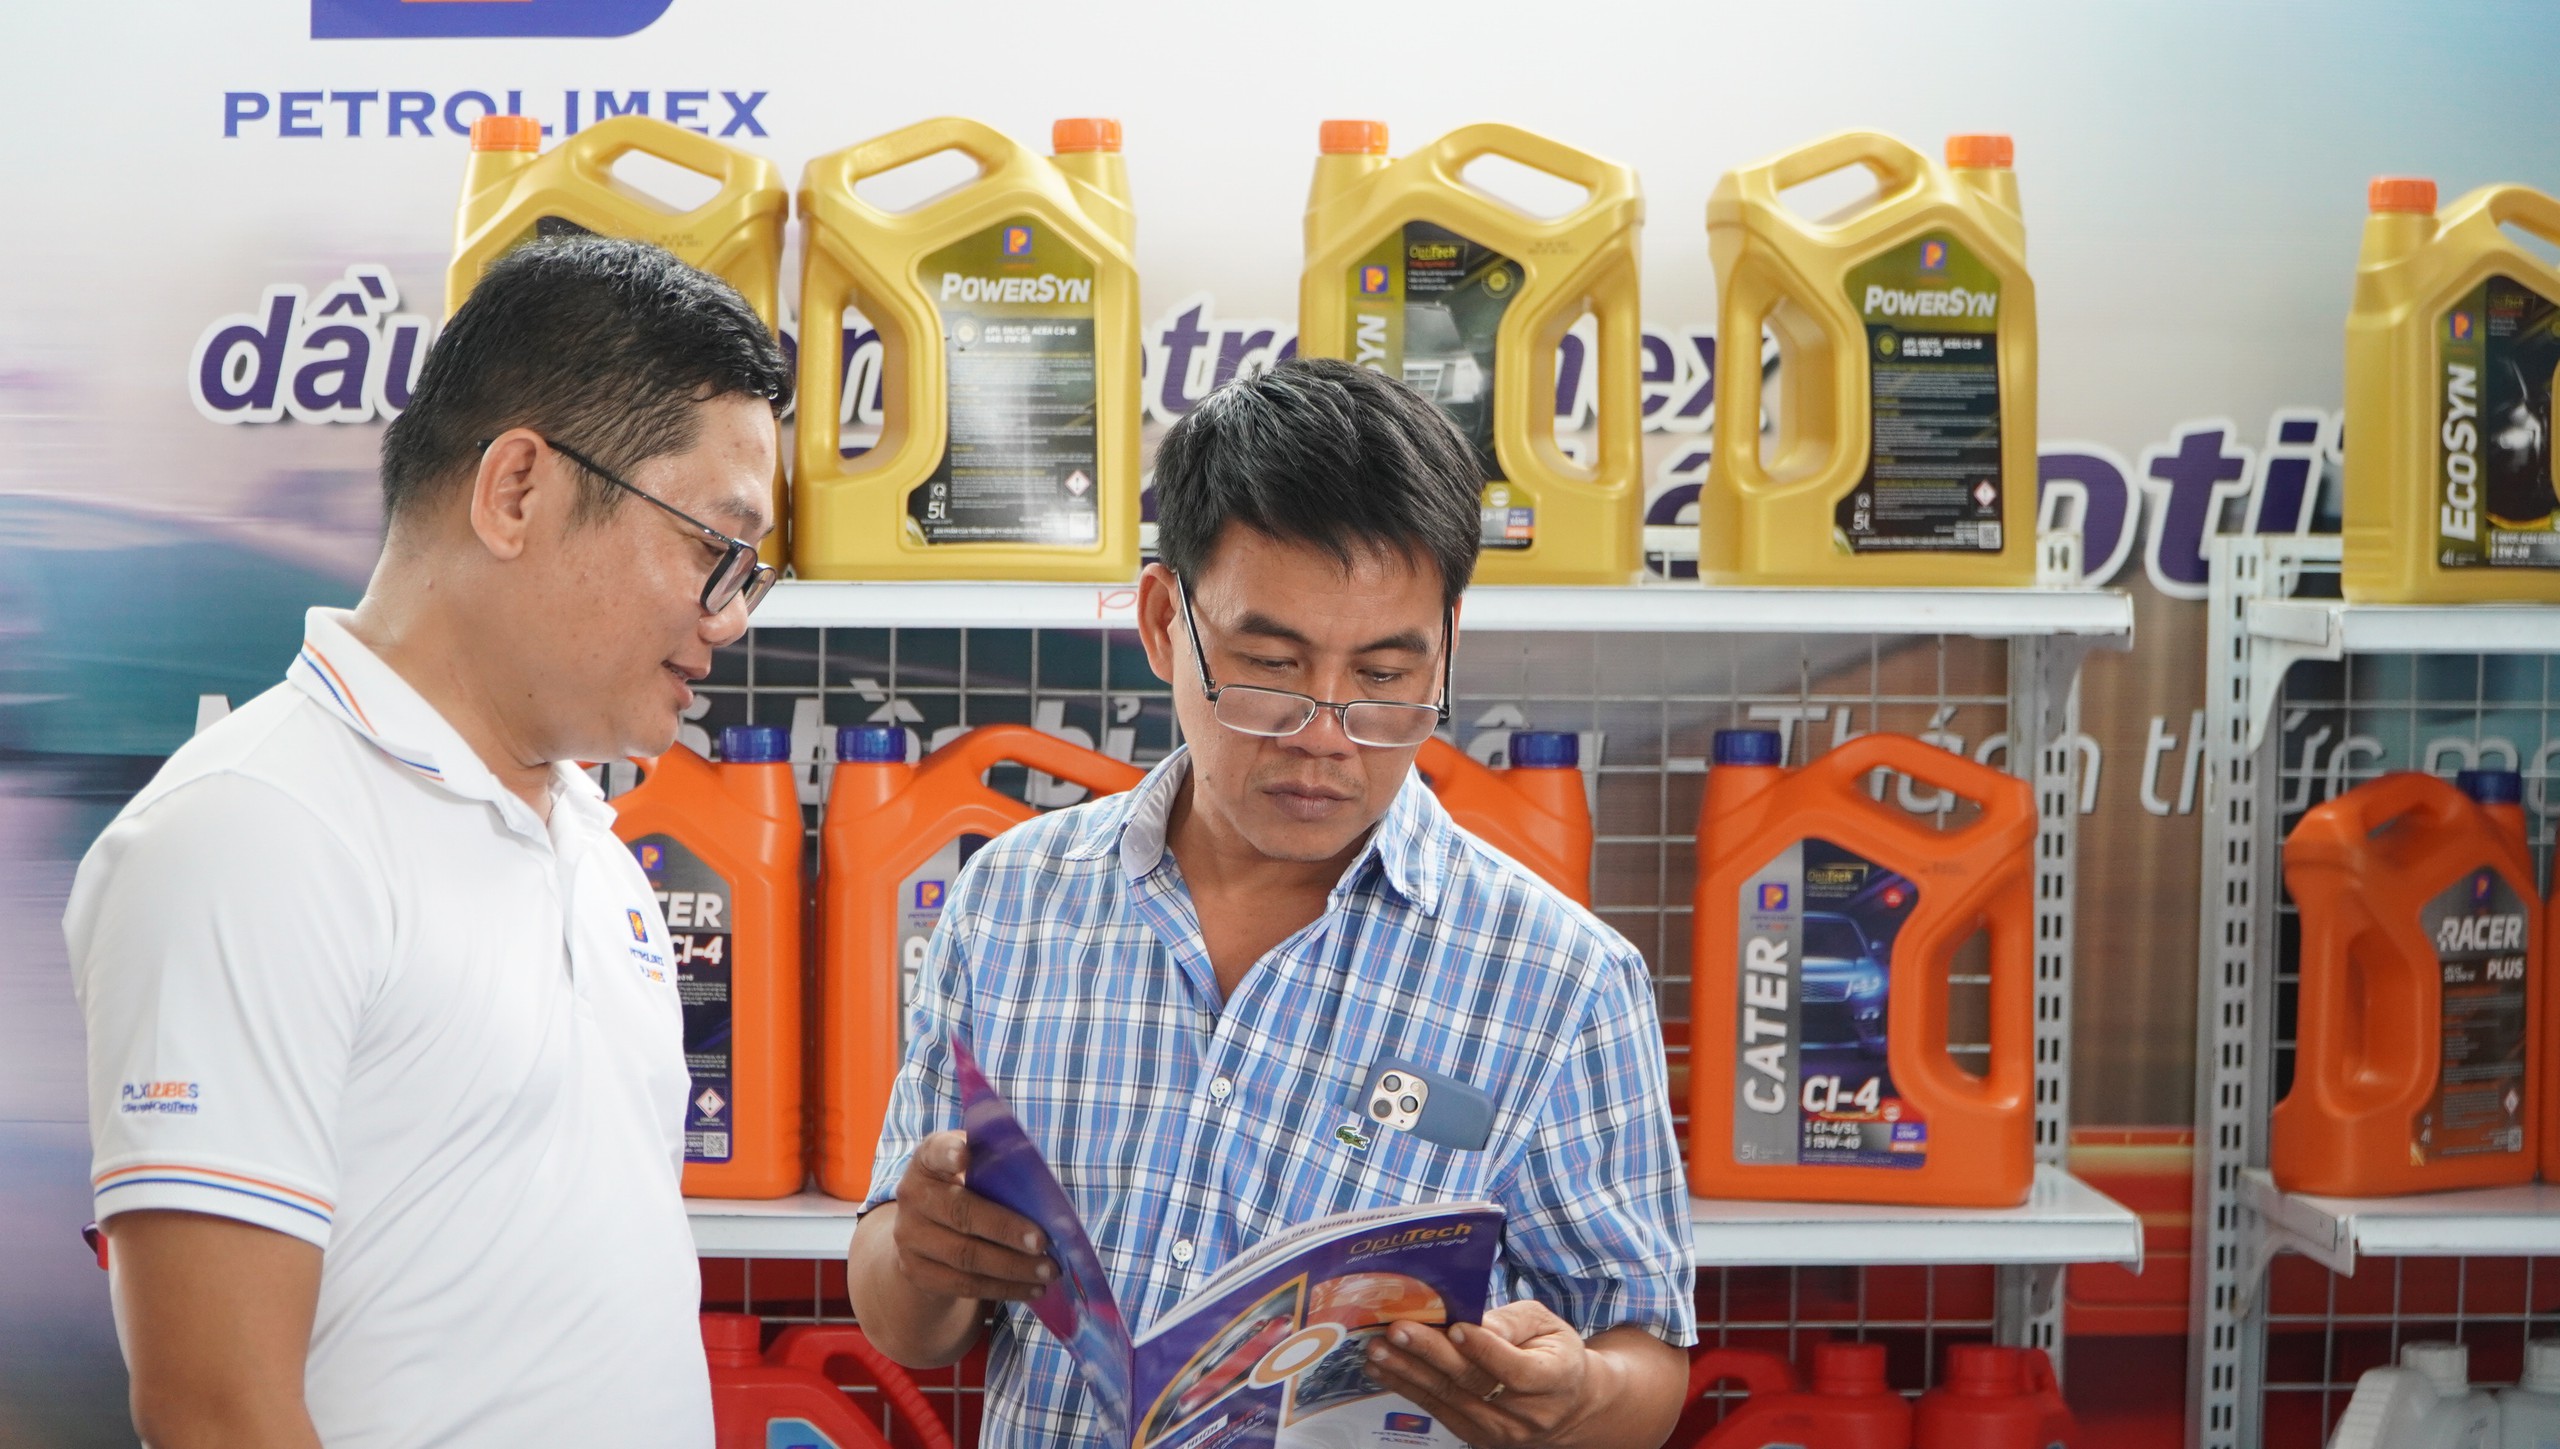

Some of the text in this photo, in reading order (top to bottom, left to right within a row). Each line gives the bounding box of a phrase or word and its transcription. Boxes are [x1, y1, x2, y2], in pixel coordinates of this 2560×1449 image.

[2437, 914, 2522, 952] RACER
[2486, 957, 2525, 980] PLUS
[1743, 936, 1789, 1115] CATER
[1802, 1074, 1881, 1114] CI-4
[1813, 1135, 1862, 1150] 15W-40
[1350, 1223, 1473, 1255] OptiTech
